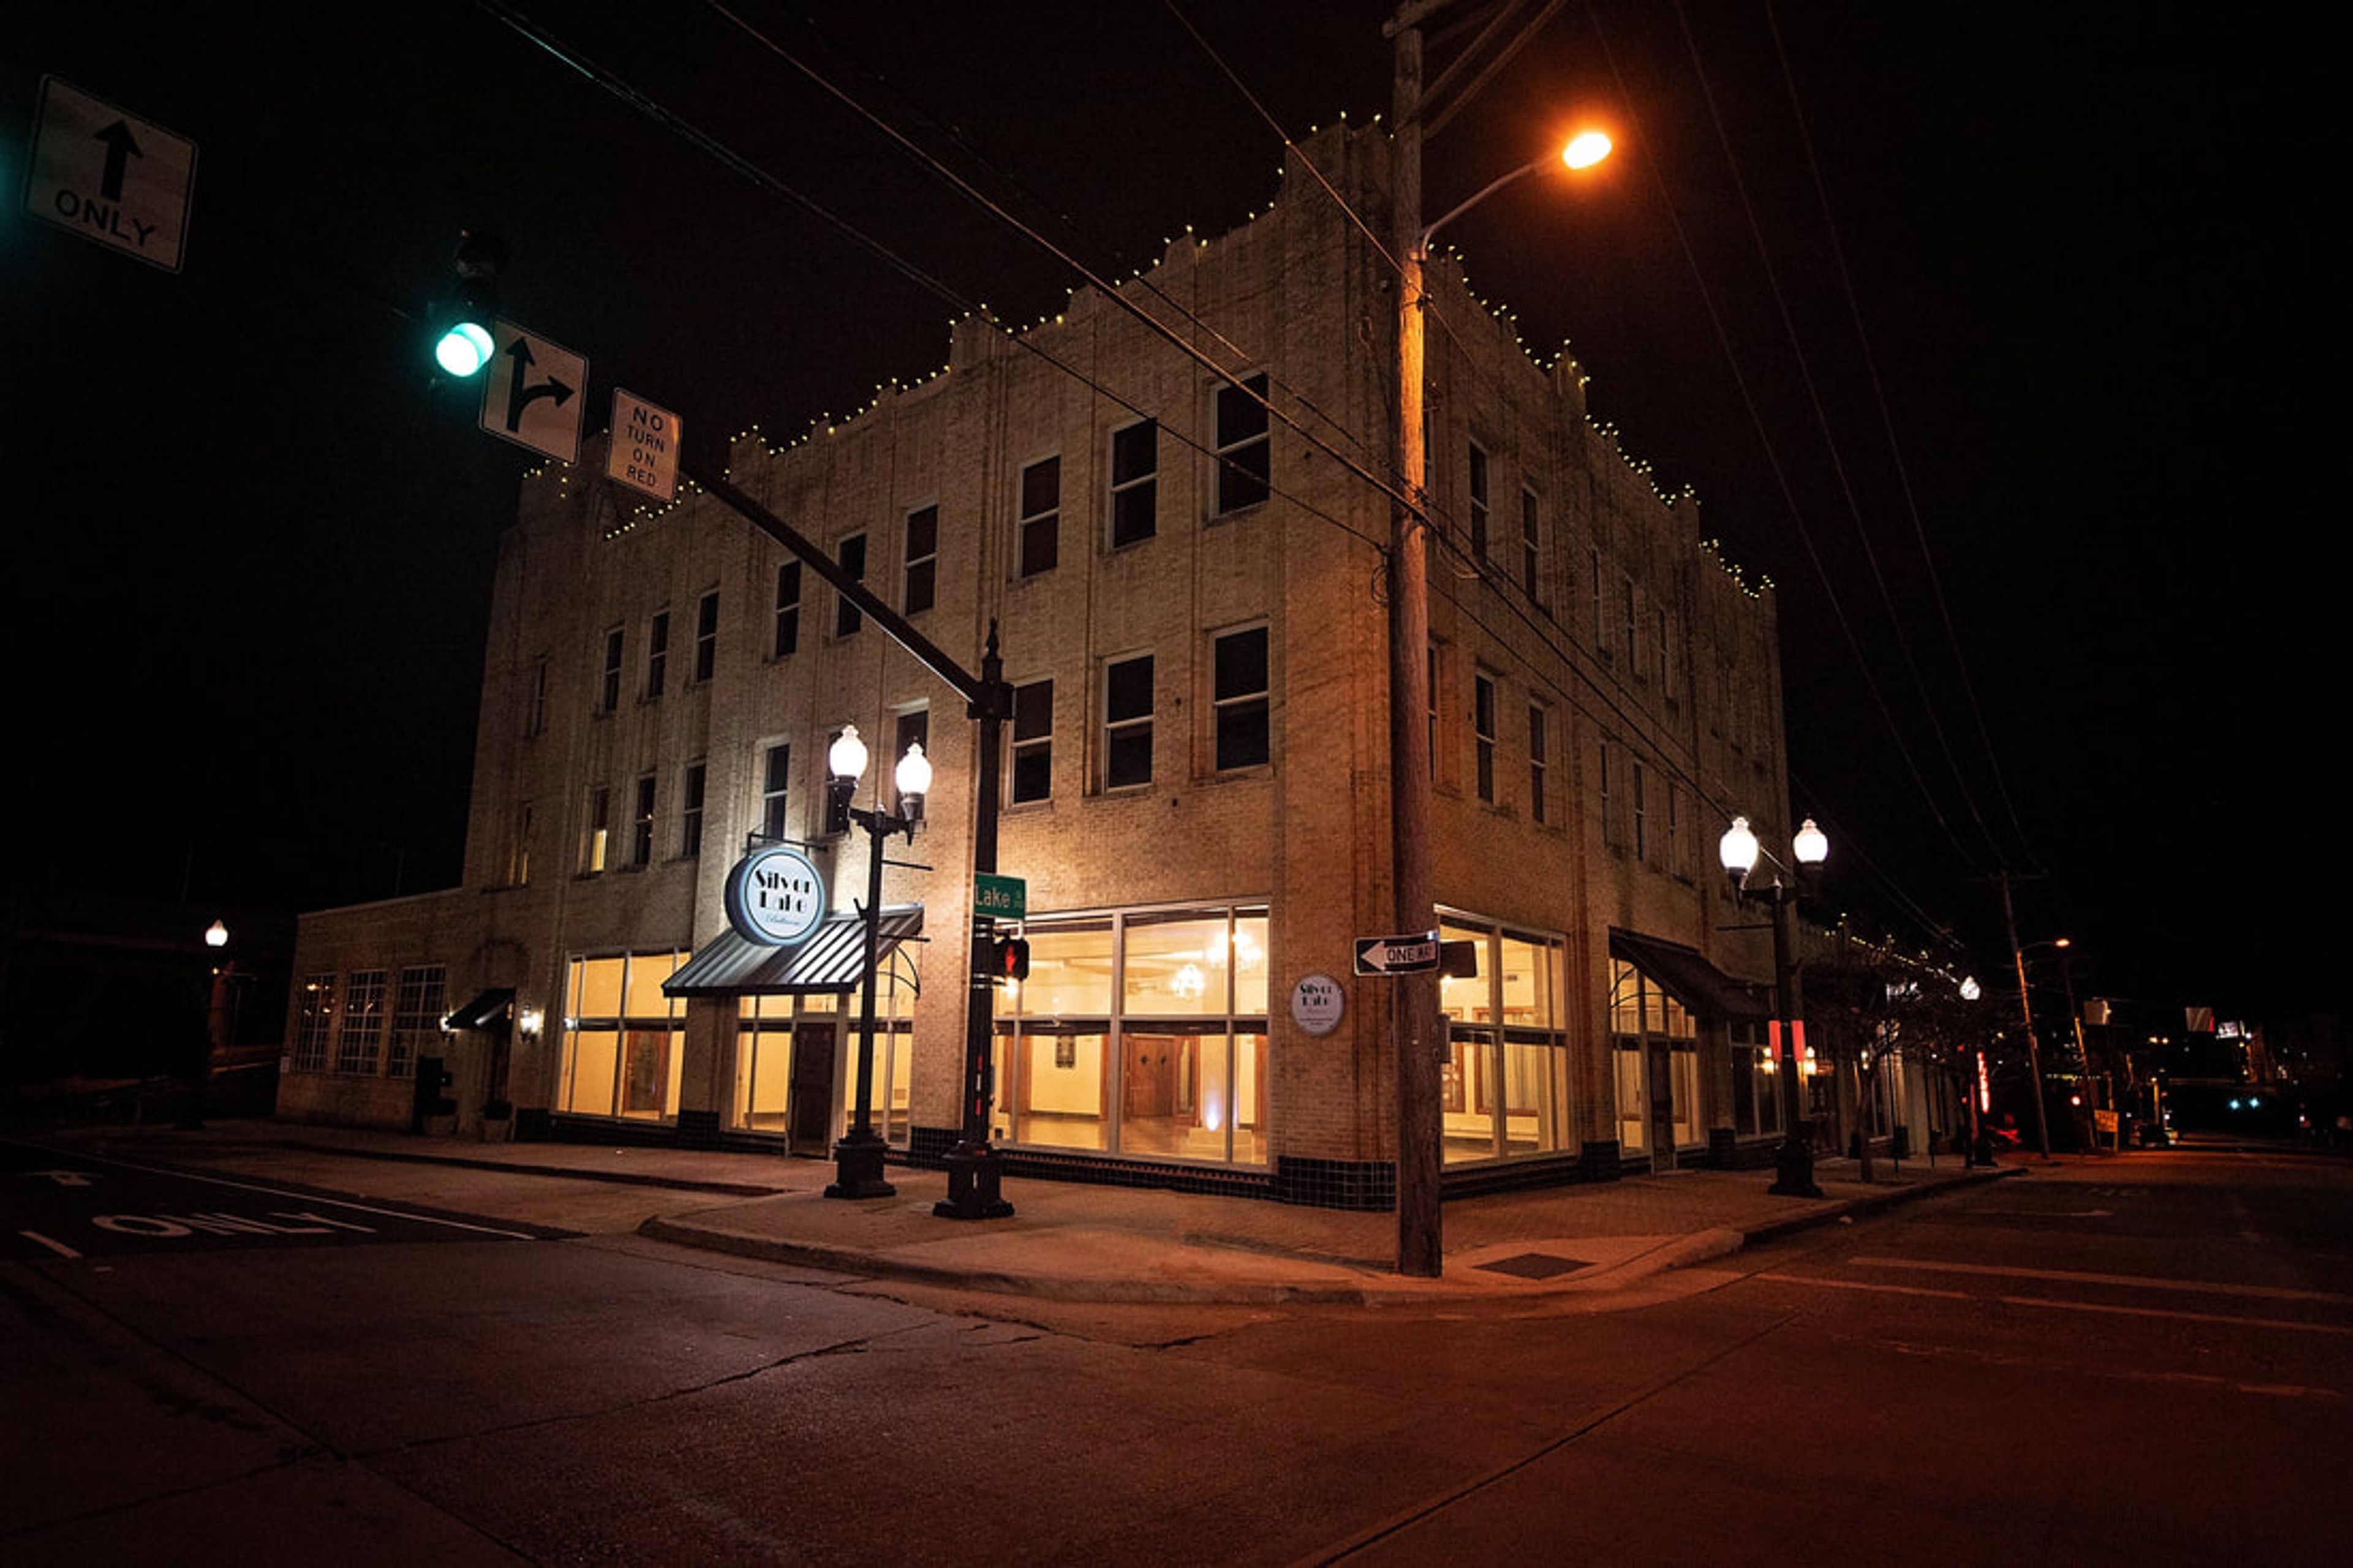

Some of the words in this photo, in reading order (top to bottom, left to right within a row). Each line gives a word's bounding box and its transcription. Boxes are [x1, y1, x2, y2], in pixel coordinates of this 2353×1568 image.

[56, 190, 154, 246] ONLY
[633, 406, 663, 431] NO
[628, 425, 664, 452] TURN
[633, 448, 655, 468] ON
[627, 464, 656, 487] RED
[754, 869, 813, 894] Silver
[759, 890, 807, 913] Lake
[975, 883, 1010, 909] Lake
[1387, 948, 1415, 961] ONE
[91, 1213, 377, 1237] ONLY
